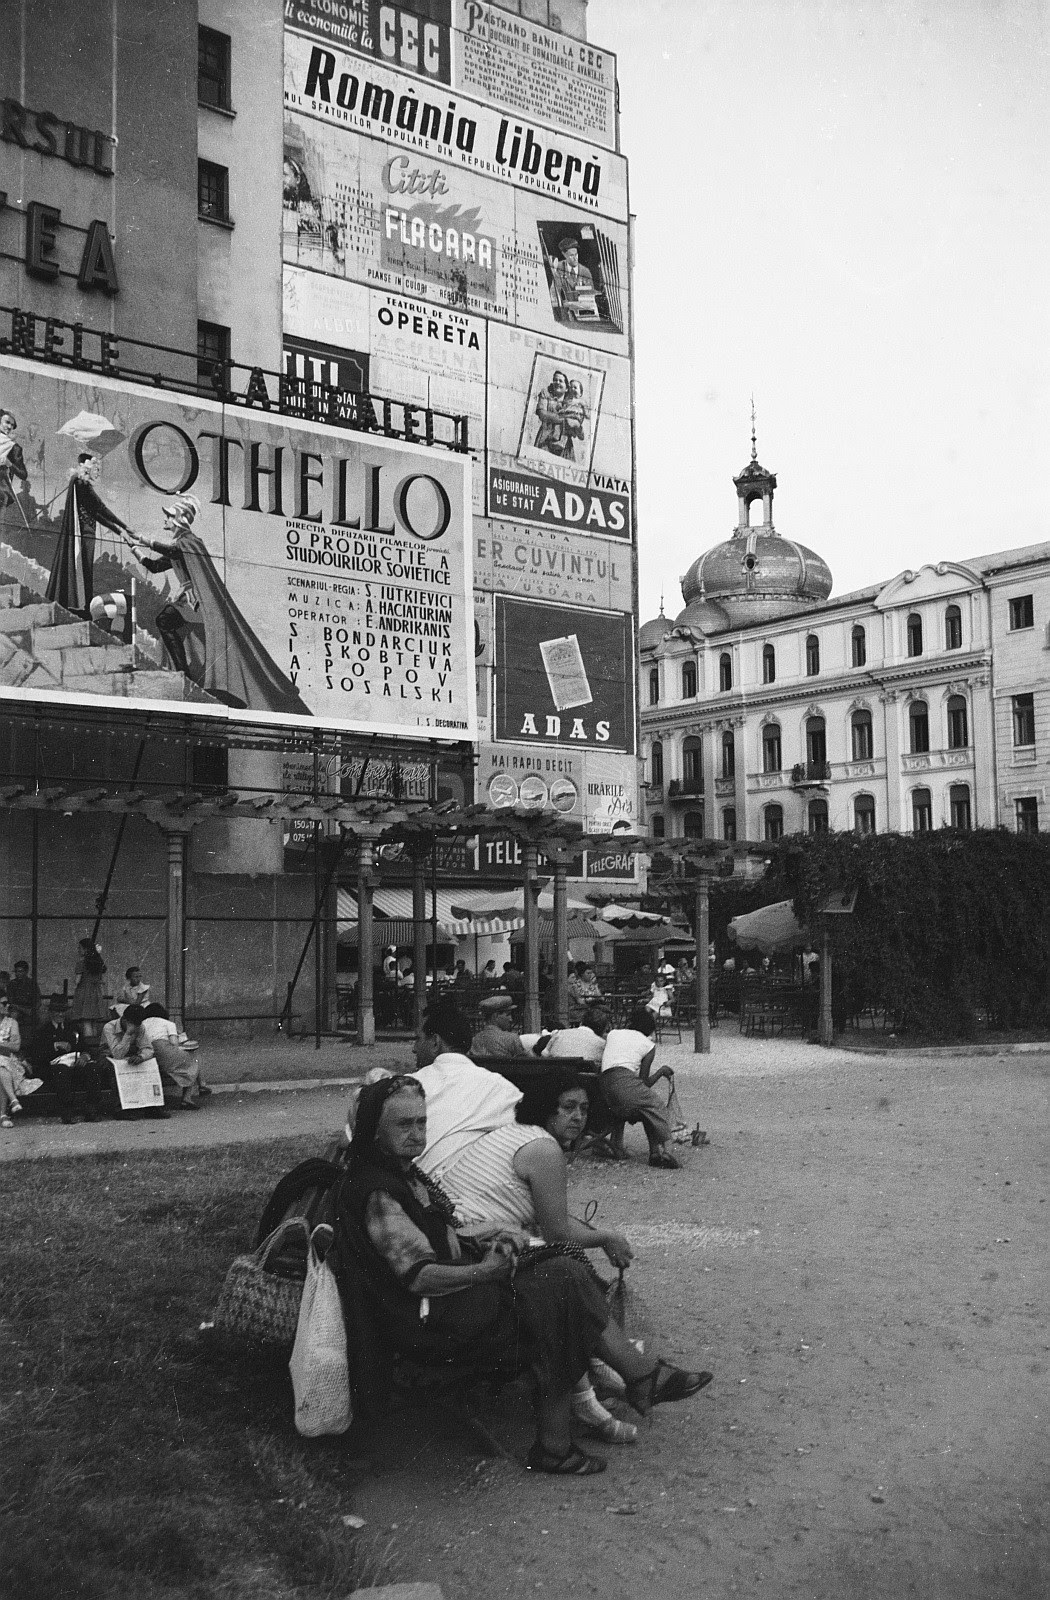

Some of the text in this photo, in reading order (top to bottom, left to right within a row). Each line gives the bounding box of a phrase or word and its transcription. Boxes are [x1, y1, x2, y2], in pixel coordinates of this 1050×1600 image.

[360, 30, 374, 49] la
[379, 6, 439, 73] CEC
[478, 24, 486, 36] VA
[522, 42, 530, 53] DE
[532, 33, 557, 51] BANII
[563, 45, 573, 57] LA
[580, 48, 602, 69] CEC
[311, 100, 371, 130] SFATURILOR
[380, 125, 430, 149] POPULARE
[438, 144, 453, 157] DIN
[461, 153, 512, 179] REPUBLICA
[519, 174, 561, 195] POPULARA
[568, 190, 599, 208] ROMANA
[0, 191, 119, 296] EA
[385, 208, 492, 270] FLACARA
[395, 276, 402, 286] IN
[386, 296, 470, 327] TEATRUL DE STAT
[377, 307, 480, 351] OPERETA
[128, 420, 451, 541] OTHELLO
[594, 475, 629, 494] VIATA
[492, 477, 540, 498] ASIGURARILE
[540, 487, 625, 530] ADAS
[496, 493, 534, 511] DE STAT
[285, 520, 426, 550] DIRECTIA DIFUZARII FILMELOR
[487, 522, 570, 543] ESTRADA
[286, 529, 299, 545] O
[310, 534, 426, 566] PRODUCTIE
[440, 555, 449, 570] A
[286, 545, 382, 574] STUDIOURILOR
[387, 563, 451, 585] SOVIETICE
[477, 538, 503, 560] ER
[514, 545, 619, 581] CUVINTUL
[323, 627, 451, 657] BONDARCIUK
[325, 659, 447, 687] POPOV
[326, 675, 452, 703] SOSALSKI
[521, 712, 610, 742] ADAS
[491, 755, 509, 768] MAI
[513, 756, 542, 770] RAPID
